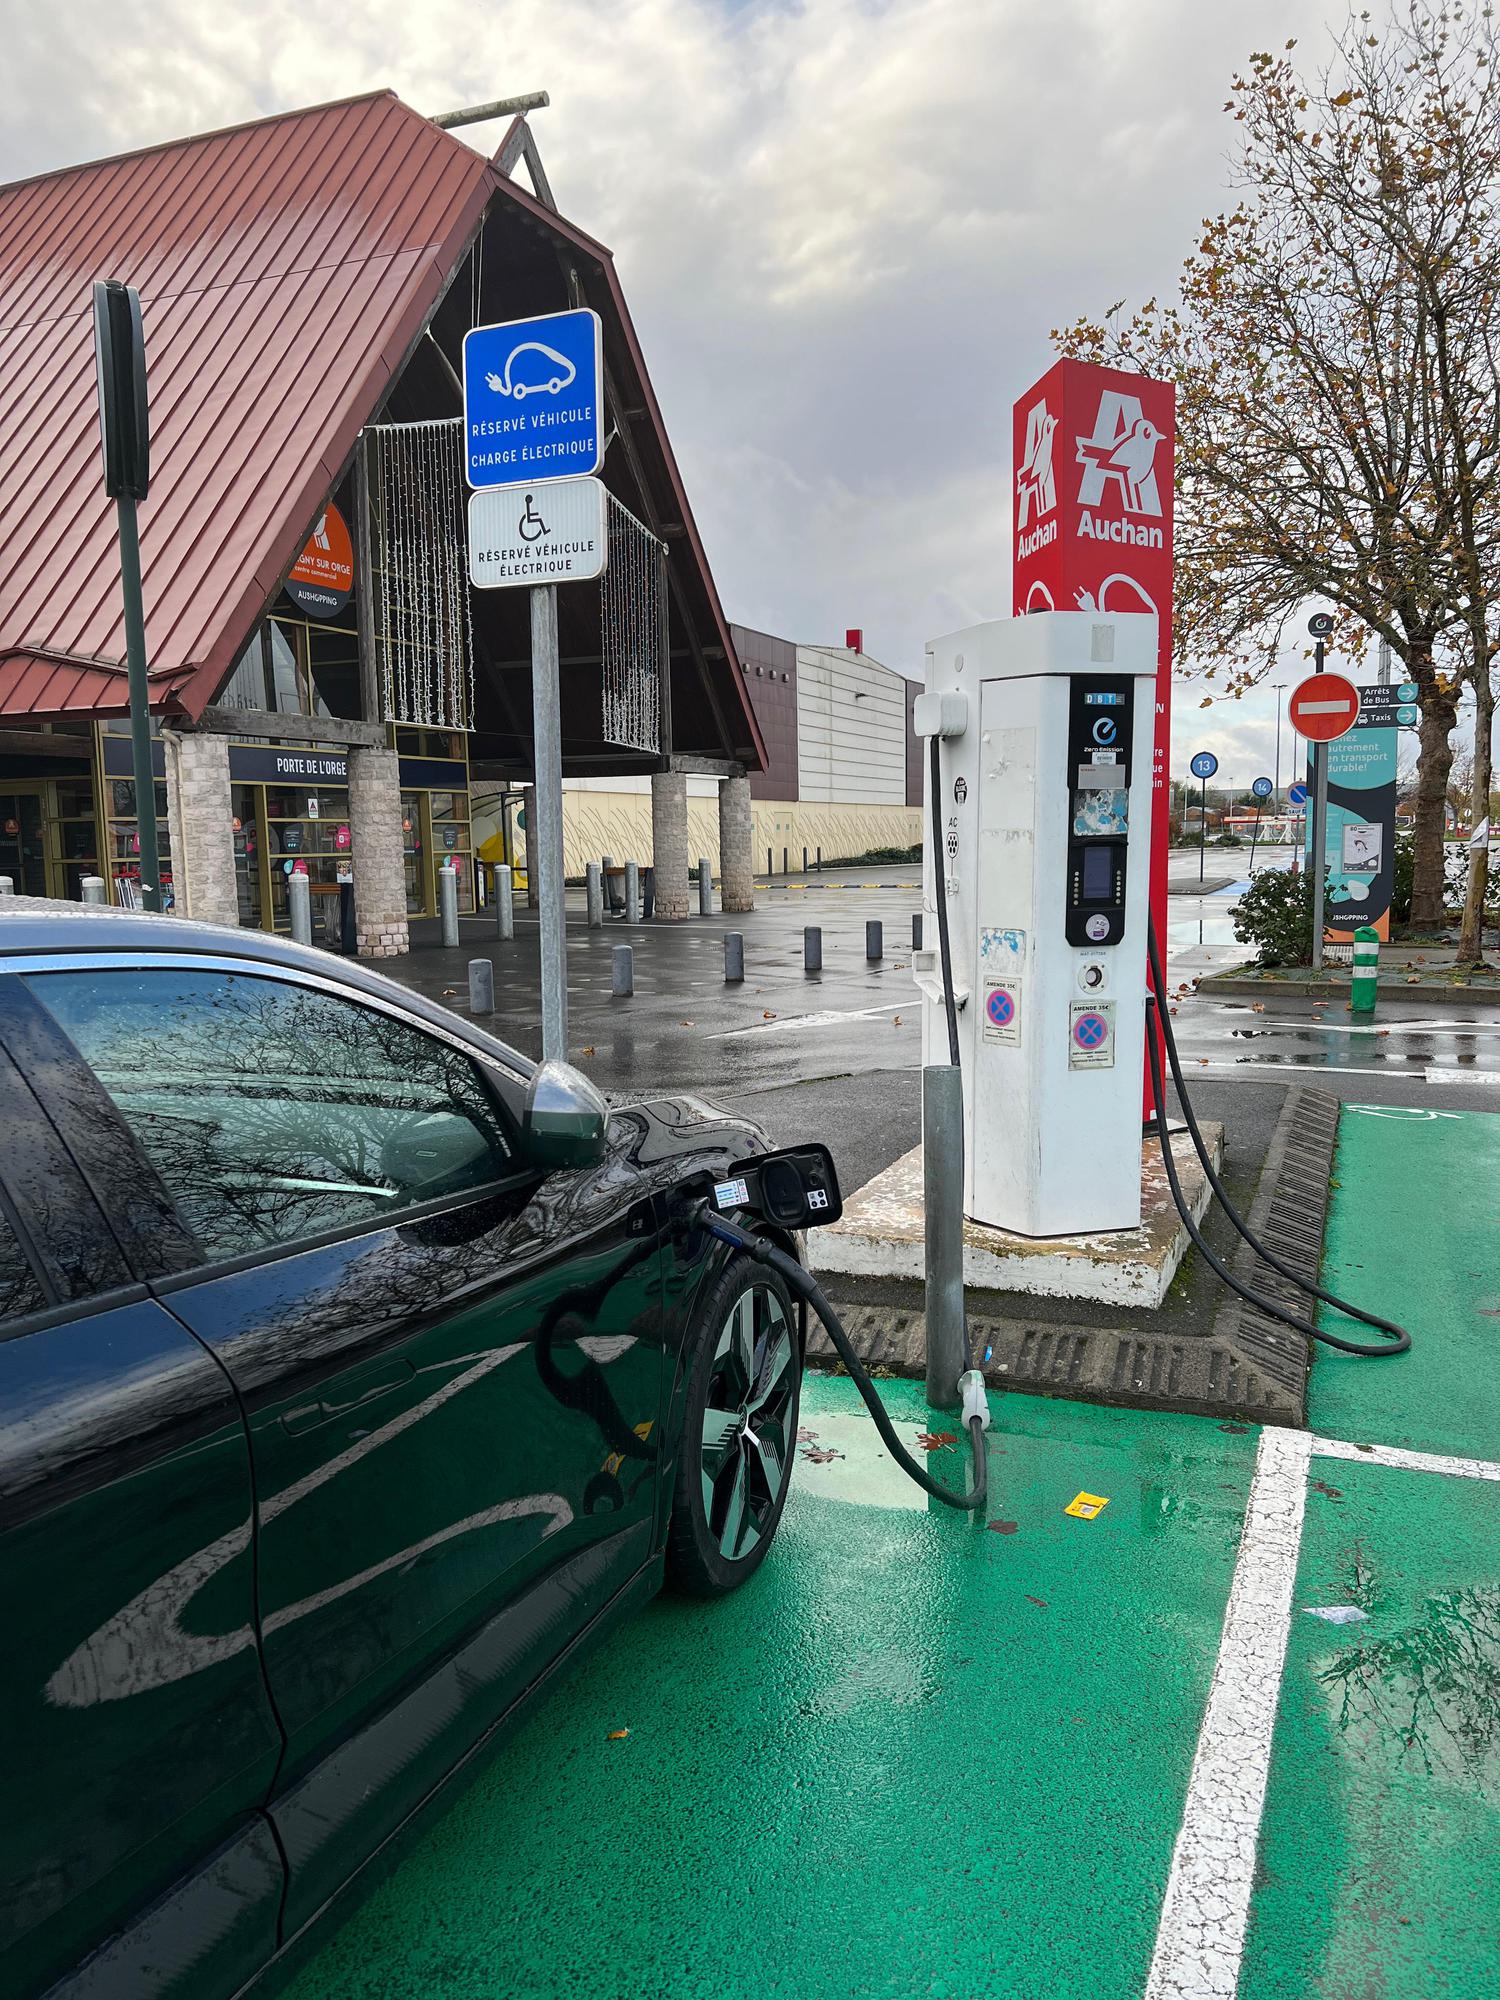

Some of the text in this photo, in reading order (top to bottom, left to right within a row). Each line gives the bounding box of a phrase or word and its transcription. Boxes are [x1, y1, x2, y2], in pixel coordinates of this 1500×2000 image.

[472, 406, 592, 437] RÉSERVÉ VÉHICULE
[471, 438, 594, 468] CHARGE ÉLECTRIQUE
[1077, 510, 1163, 549] Auchan
[1017, 518, 1058, 562] Auchan
[478, 540, 594, 563] RÉSERVÉ VÉHICULE
[316, 558, 330, 570] SUR
[331, 562, 351, 575] ORGE
[500, 559, 572, 577] ÉLECTRIQUE
[298, 590, 338, 606] AUSHOPPING
[1364, 687, 1390, 695] Arrêts
[1363, 696, 1390, 704] de Bus
[1371, 714, 1391, 722] Taxis
[1198, 761, 1210, 771] 13
[1341, 753, 1388, 764] transport
[276, 758, 347, 776] PORTE DE L'ORGE
[1258, 784, 1266, 792] 14
[949, 817, 958, 827] AC
[986, 981, 1006, 989] AMENDE
